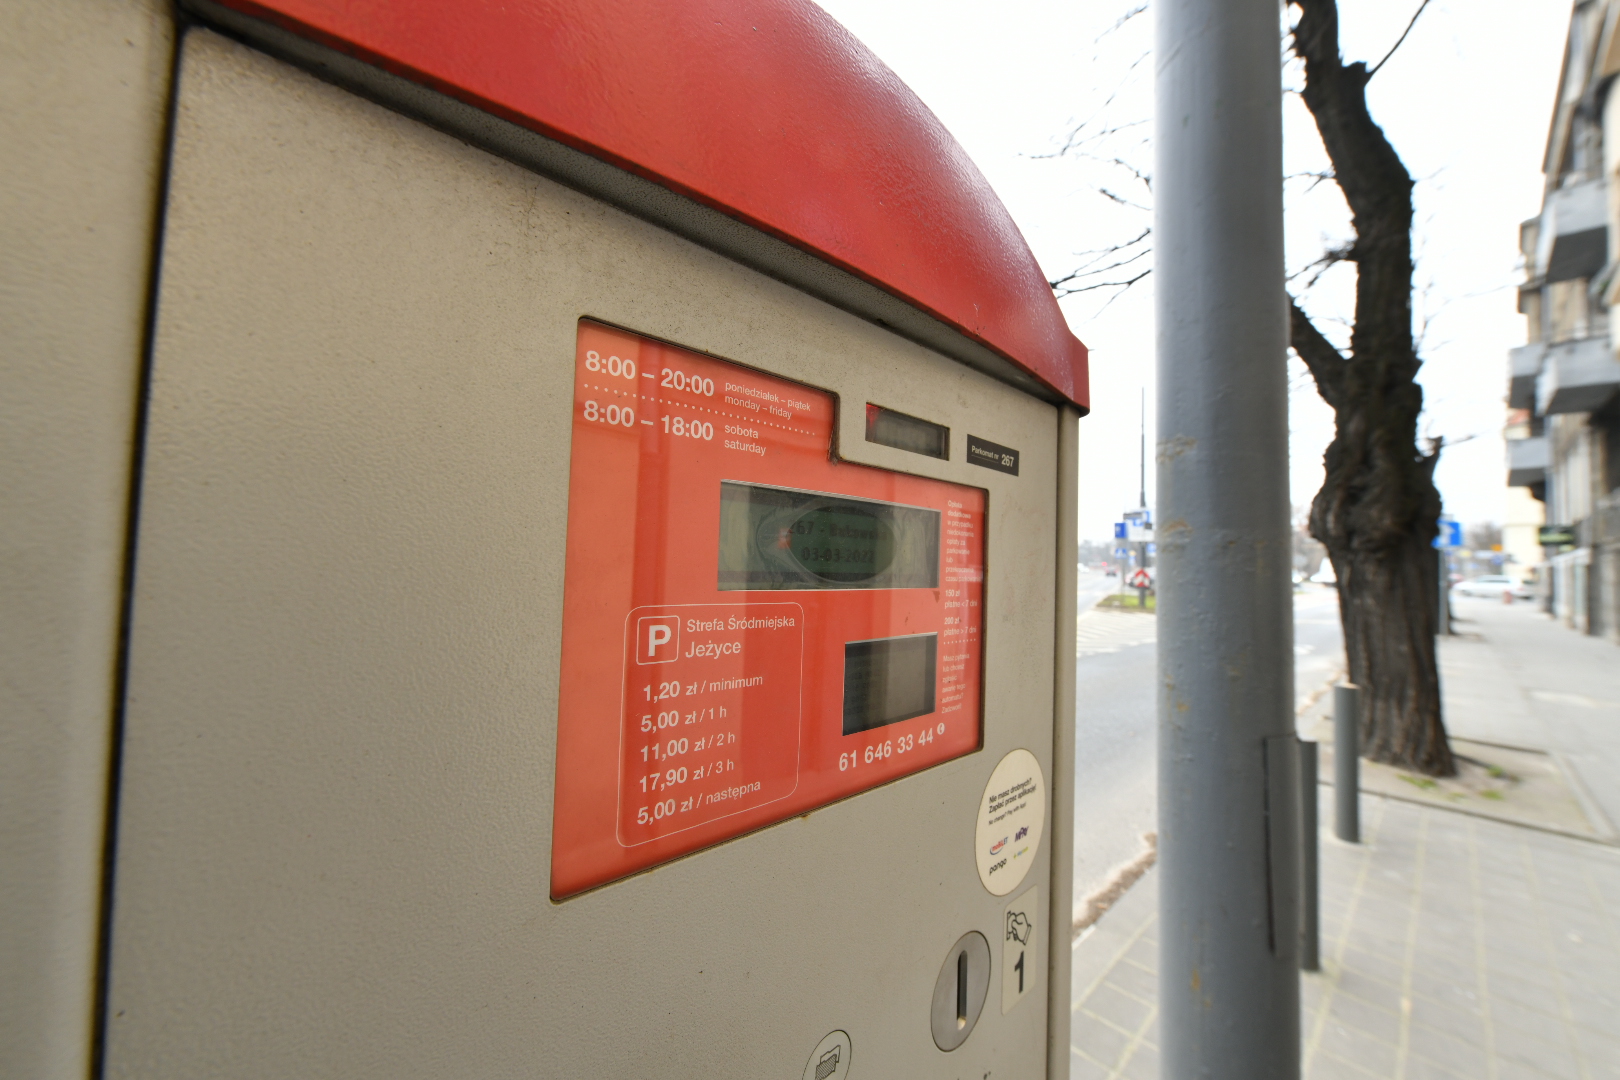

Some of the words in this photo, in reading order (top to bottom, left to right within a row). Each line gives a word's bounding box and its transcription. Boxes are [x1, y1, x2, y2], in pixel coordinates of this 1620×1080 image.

[585, 350, 636, 380] 8:00
[660, 368, 714, 397] 20:00
[724, 395, 760, 413] monday
[769, 406, 792, 420] friday
[725, 382, 780, 403] poniedziałek
[787, 398, 811, 412] piątek
[583, 400, 634, 428] 8:00
[661, 414, 714, 441] 18:00
[724, 424, 759, 439] sobota
[724, 439, 766, 456] saturday
[972, 445, 994, 459] Parkomat
[1001, 453, 1014, 468] 267
[945, 589, 954, 597] 150
[945, 600, 960, 610] płatne
[944, 617, 954, 625] 200
[944, 627, 960, 637] płatne
[648, 624, 672, 657] P
[686, 618, 724, 632] Strefa
[727, 614, 795, 632] Śródmiejska
[685, 640, 741, 660] Jeżyce
[643, 681, 680, 703] 1,20
[685, 681, 697, 696] zł
[700, 680, 707, 694] /
[709, 674, 763, 692] minimum
[640, 710, 679, 734] 5,00
[684, 710, 696, 725] zł
[699, 708, 705, 722] /
[709, 707, 714, 720] 1
[719, 706, 727, 718] h
[640, 738, 688, 762] 11,00
[694, 735, 705, 751] zł
[708, 734, 714, 748] /
[716, 733, 724, 746] 2
[728, 732, 735, 744] h
[839, 750, 857, 772] 61
[864, 740, 892, 764] 646
[897, 734, 914, 754] 33
[918, 728, 934, 746] 44
[639, 766, 688, 793] 17,90
[693, 764, 704, 781] zł
[707, 763, 713, 777] /
[715, 760, 723, 774] 3
[726, 758, 734, 772] h
[636, 798, 676, 826] 5,00
[680, 796, 693, 812] zł
[696, 793, 702, 809] /
[705, 780, 761, 805] następna
[989, 795, 997, 803] Nie
[998, 789, 1010, 800] masz
[1010, 777, 1032, 794] drobnych?
[989, 799, 1004, 814] Zapłać
[1005, 795, 1017, 807] przez
[989, 858, 1007, 876] pango
[1014, 950, 1024, 994] 1
